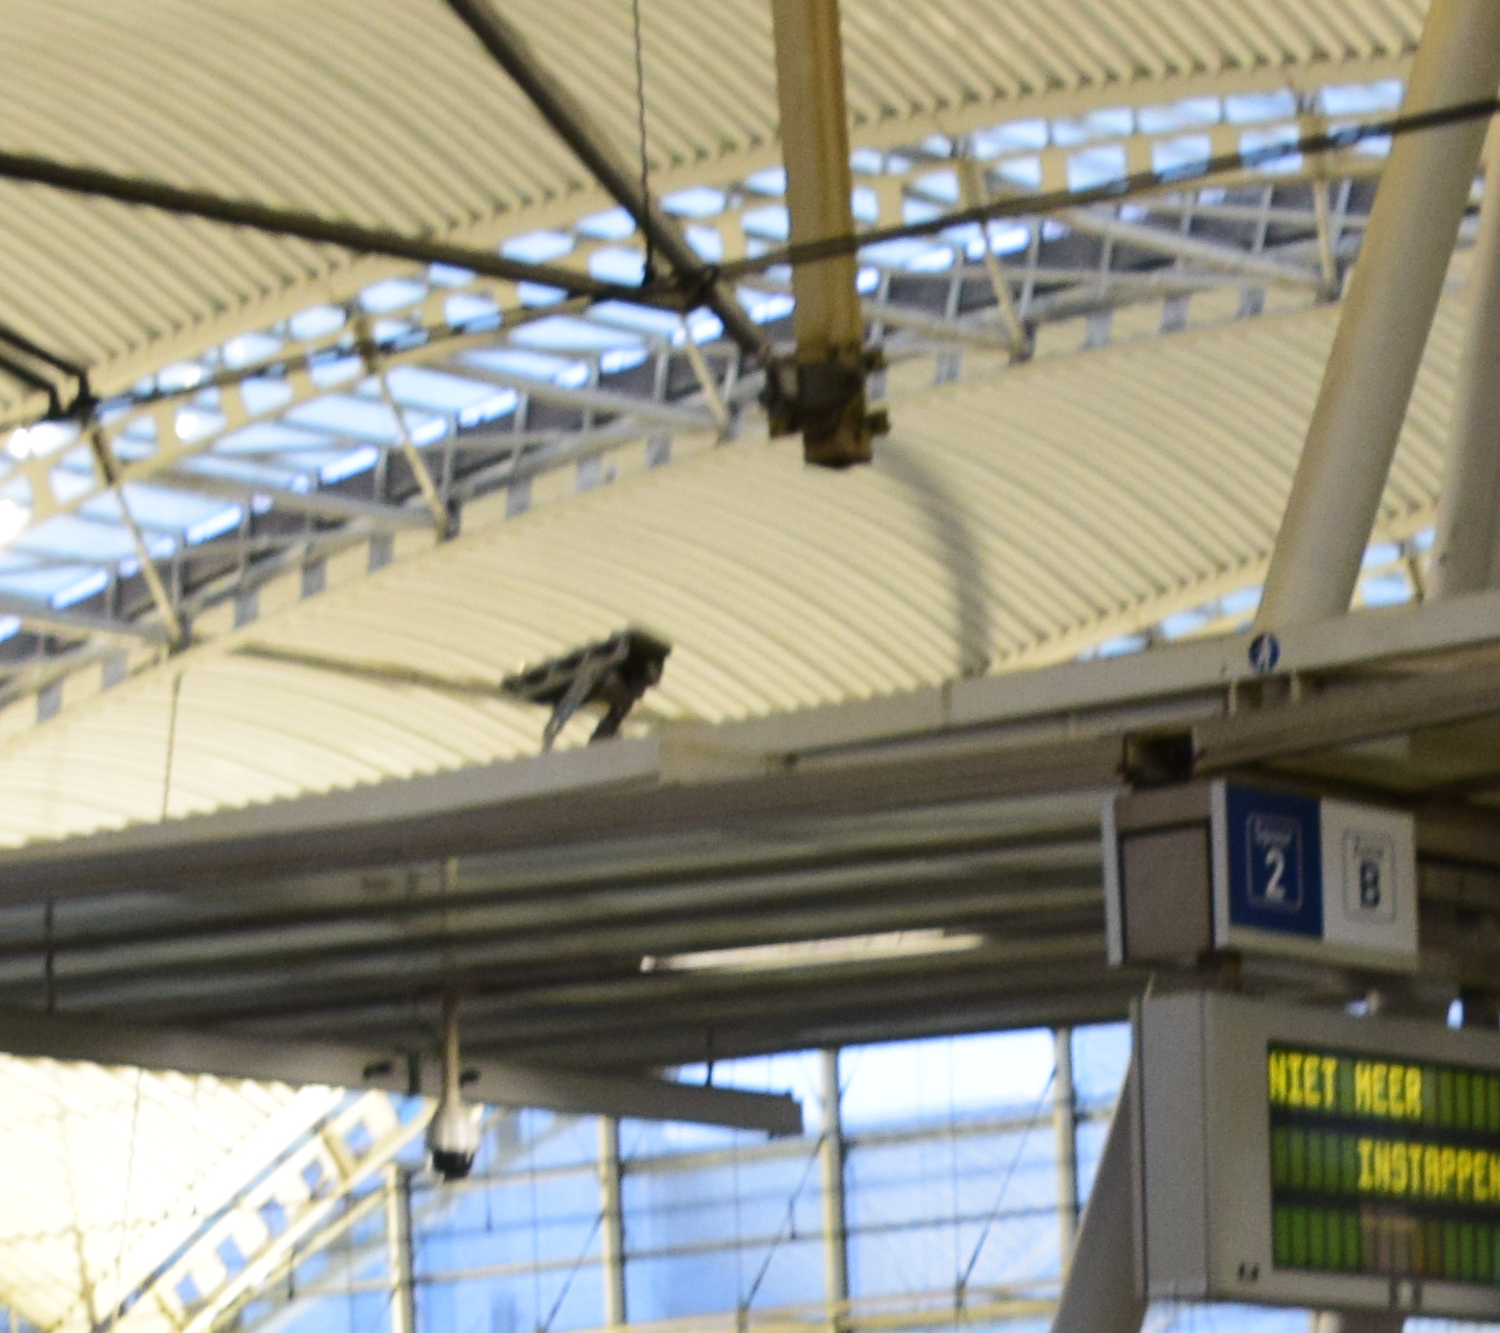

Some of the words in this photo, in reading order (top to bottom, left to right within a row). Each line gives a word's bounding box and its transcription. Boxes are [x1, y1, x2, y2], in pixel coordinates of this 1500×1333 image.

[1264, 847, 1287, 901] 2
[1359, 860, 1382, 909] B
[1268, 1051, 1338, 1110] NIET
[1354, 1060, 1423, 1120] MEER
